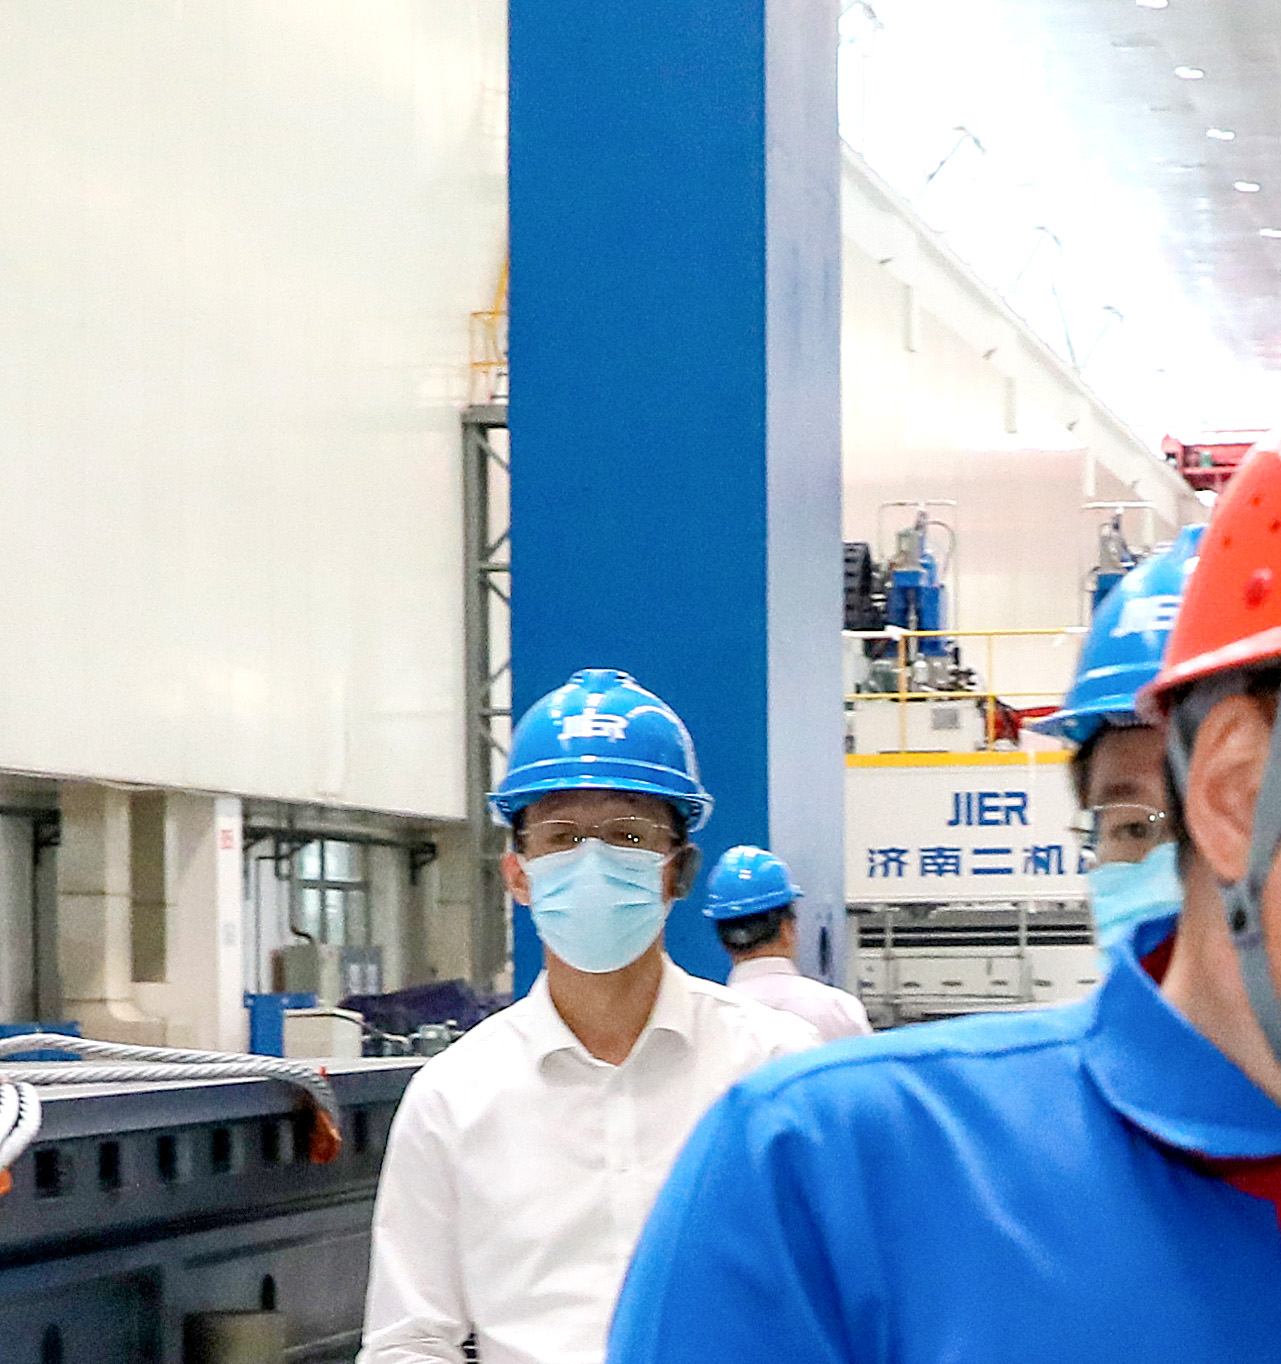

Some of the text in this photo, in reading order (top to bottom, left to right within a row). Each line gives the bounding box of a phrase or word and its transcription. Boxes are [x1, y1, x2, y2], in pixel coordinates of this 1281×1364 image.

[947, 792, 1029, 826] JIER
[867, 844, 1088, 878] 济南二机
